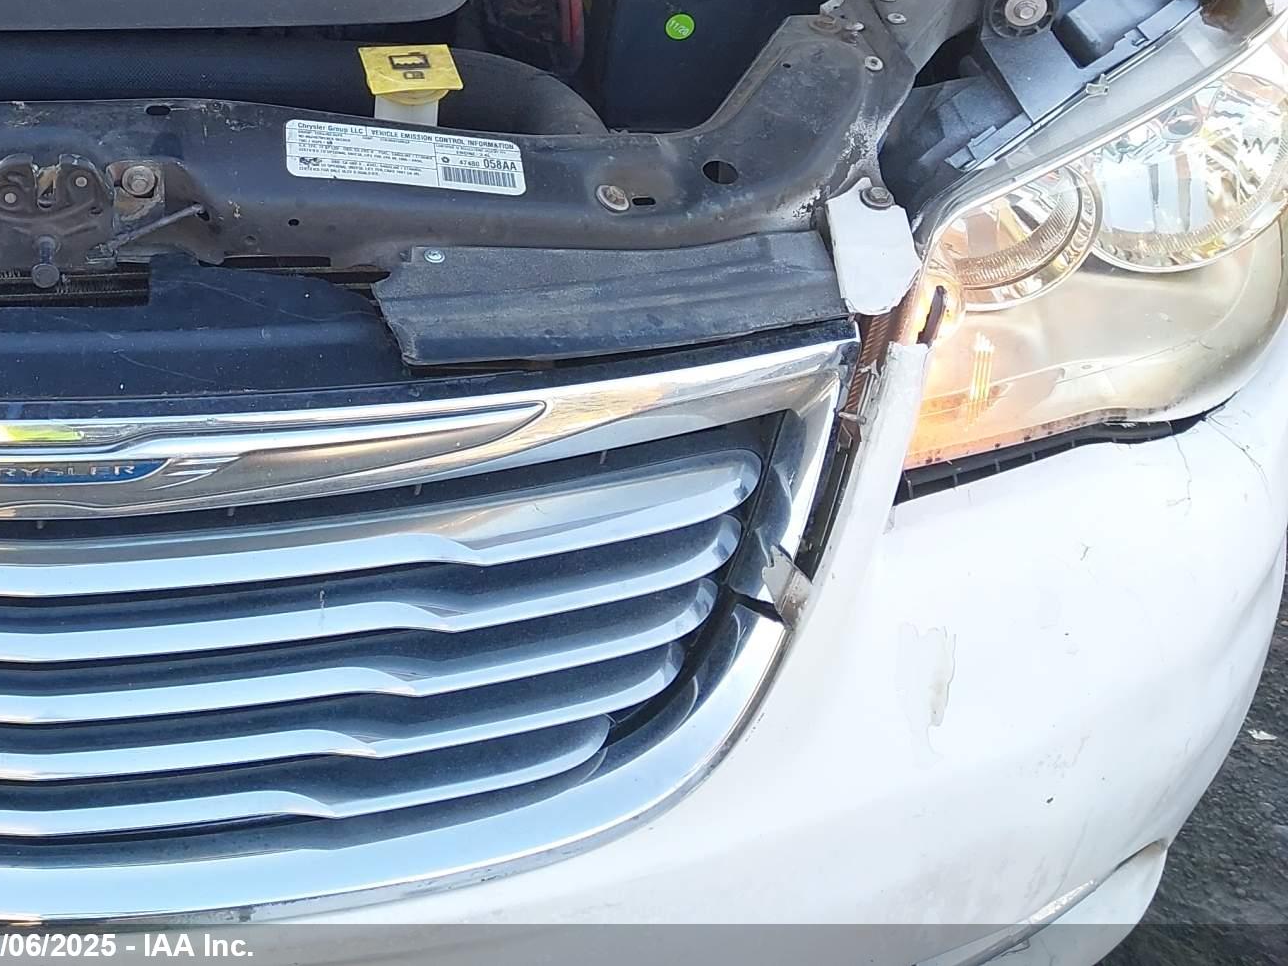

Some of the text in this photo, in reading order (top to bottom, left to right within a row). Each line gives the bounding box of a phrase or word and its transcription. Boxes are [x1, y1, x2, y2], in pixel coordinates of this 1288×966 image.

[297, 122, 326, 131] Chrysler
[328, 124, 349, 133] Group
[371, 129, 398, 137] VEHICLE
[401, 131, 432, 141] EMISSION
[435, 136, 464, 145] CONTROL
[468, 140, 514, 149] INFORMATION
[483, 158, 517, 171] 058AA
